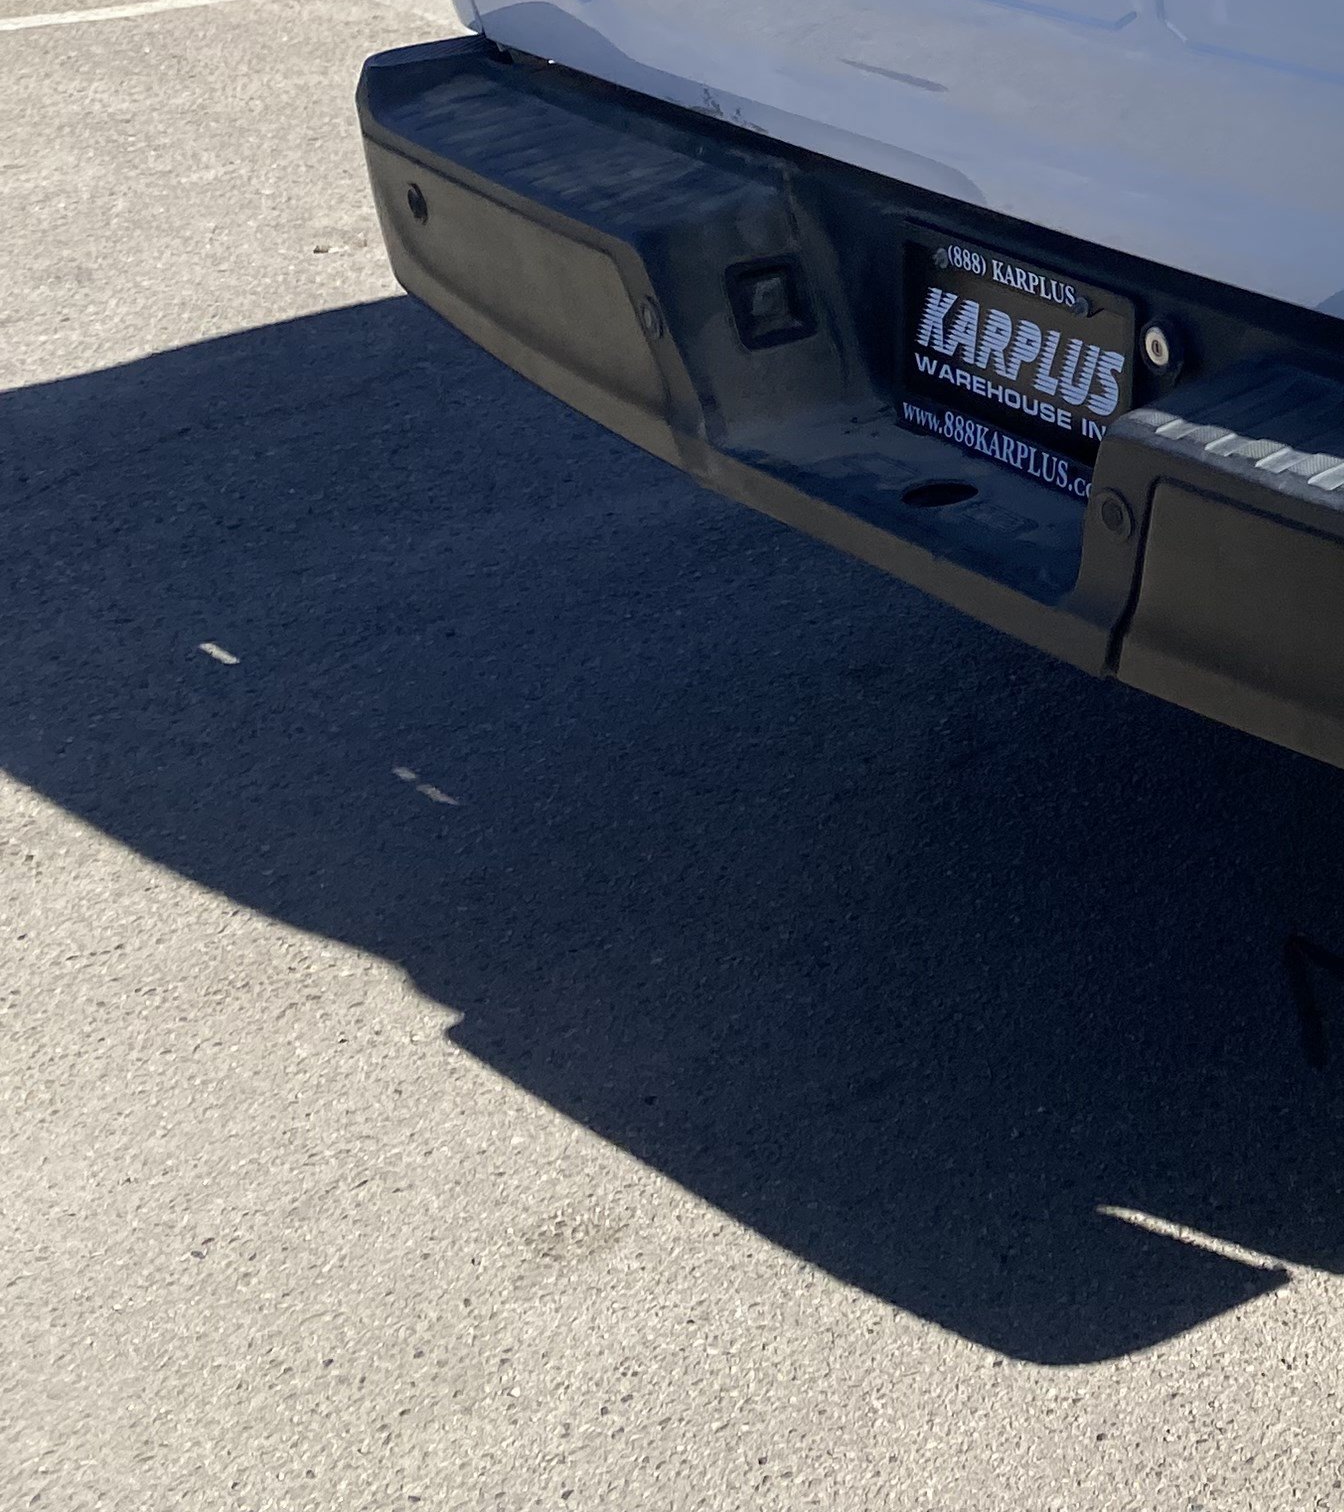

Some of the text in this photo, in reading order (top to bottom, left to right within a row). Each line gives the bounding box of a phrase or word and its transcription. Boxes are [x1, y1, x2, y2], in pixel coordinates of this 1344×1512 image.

[948, 245, 1076, 308] (888) KARPLUS
[914, 351, 1107, 442] WAREHOUSE IN
[916, 286, 1125, 417] KARPLUS
